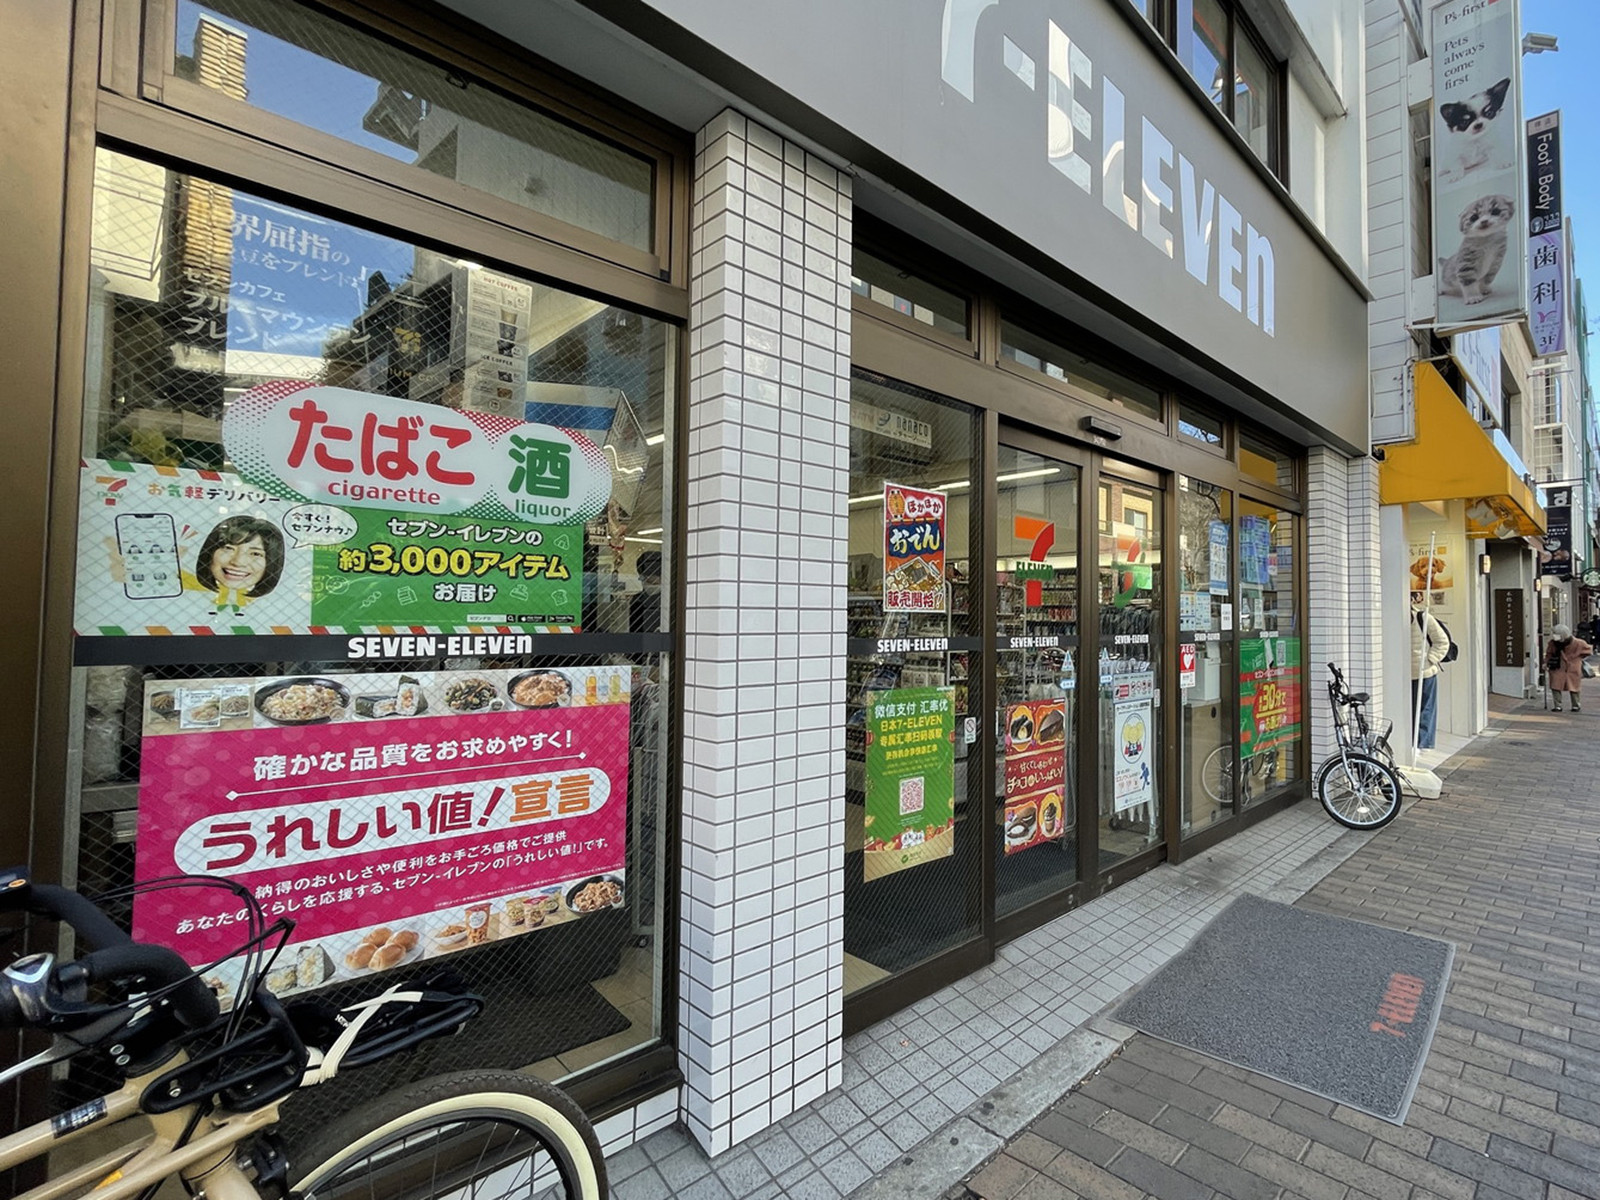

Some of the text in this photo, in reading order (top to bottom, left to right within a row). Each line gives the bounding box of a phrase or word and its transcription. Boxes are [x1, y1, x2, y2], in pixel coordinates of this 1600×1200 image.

[1444, 36, 1469, 53] Pets
[1444, 42, 1486, 65] always
[1444, 60, 1475, 78] come
[1444, 74, 1470, 91] first
[1537, 132, 1553, 166] Foot
[1535, 174, 1555, 210] Body
[1532, 243, 1559, 305] 歯科
[1540, 334, 1557, 347] 3F
[286, 399, 476, 485] たばこ
[507, 433, 572, 499] 酒
[147, 482, 281, 503] お気軽デリバリー
[327, 480, 441, 505] cigarette
[515, 498, 571, 520] liquor
[387, 517, 543, 545] セブン-イレブンの
[890, 523, 940, 553] おでん
[339, 543, 571, 581] 約3,000アイテム
[434, 582, 498, 603] お届け
[875, 701, 917, 719] 微信支付
[881, 714, 943, 732] 日本7-ELEVEN
[252, 728, 573, 782] 確かな品質をお求めやすく!
[201, 773, 595, 871] うれしい値!宣言
[255, 829, 568, 900] 納得のおいしさや便利をお手ごろ価格でご提供
